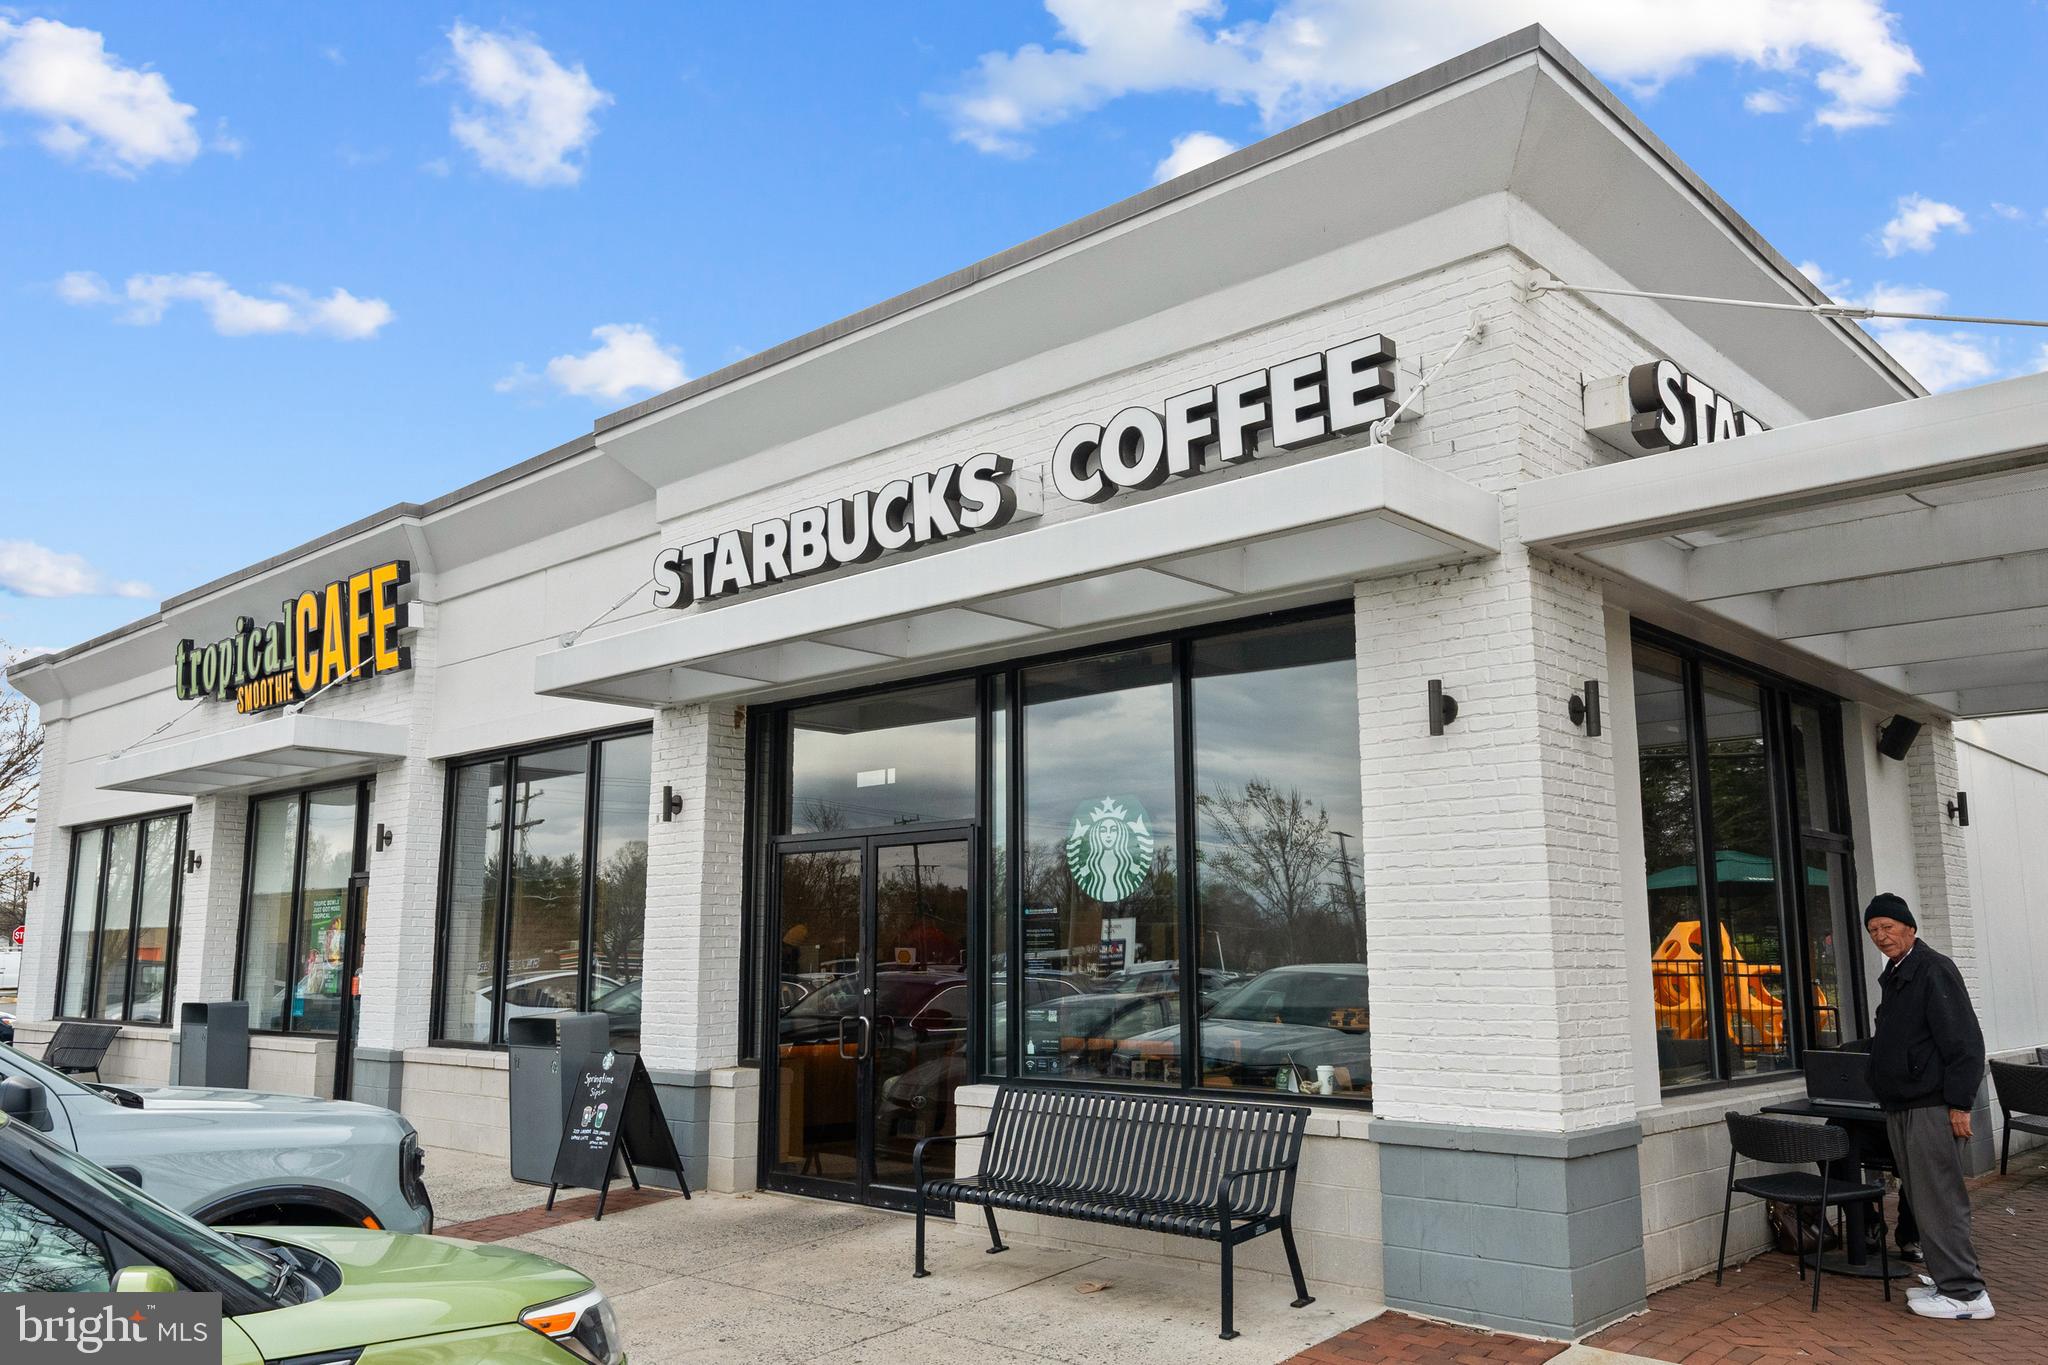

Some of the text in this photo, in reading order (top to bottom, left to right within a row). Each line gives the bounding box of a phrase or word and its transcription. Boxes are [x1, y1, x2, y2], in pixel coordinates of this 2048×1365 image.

[653, 333, 1394, 609] STARBUCKS COFFEE
[176, 561, 404, 700] tropical CAFE
[236, 671, 295, 714] SMOOTHIE
[584, 1072, 614, 1088] Springtime
